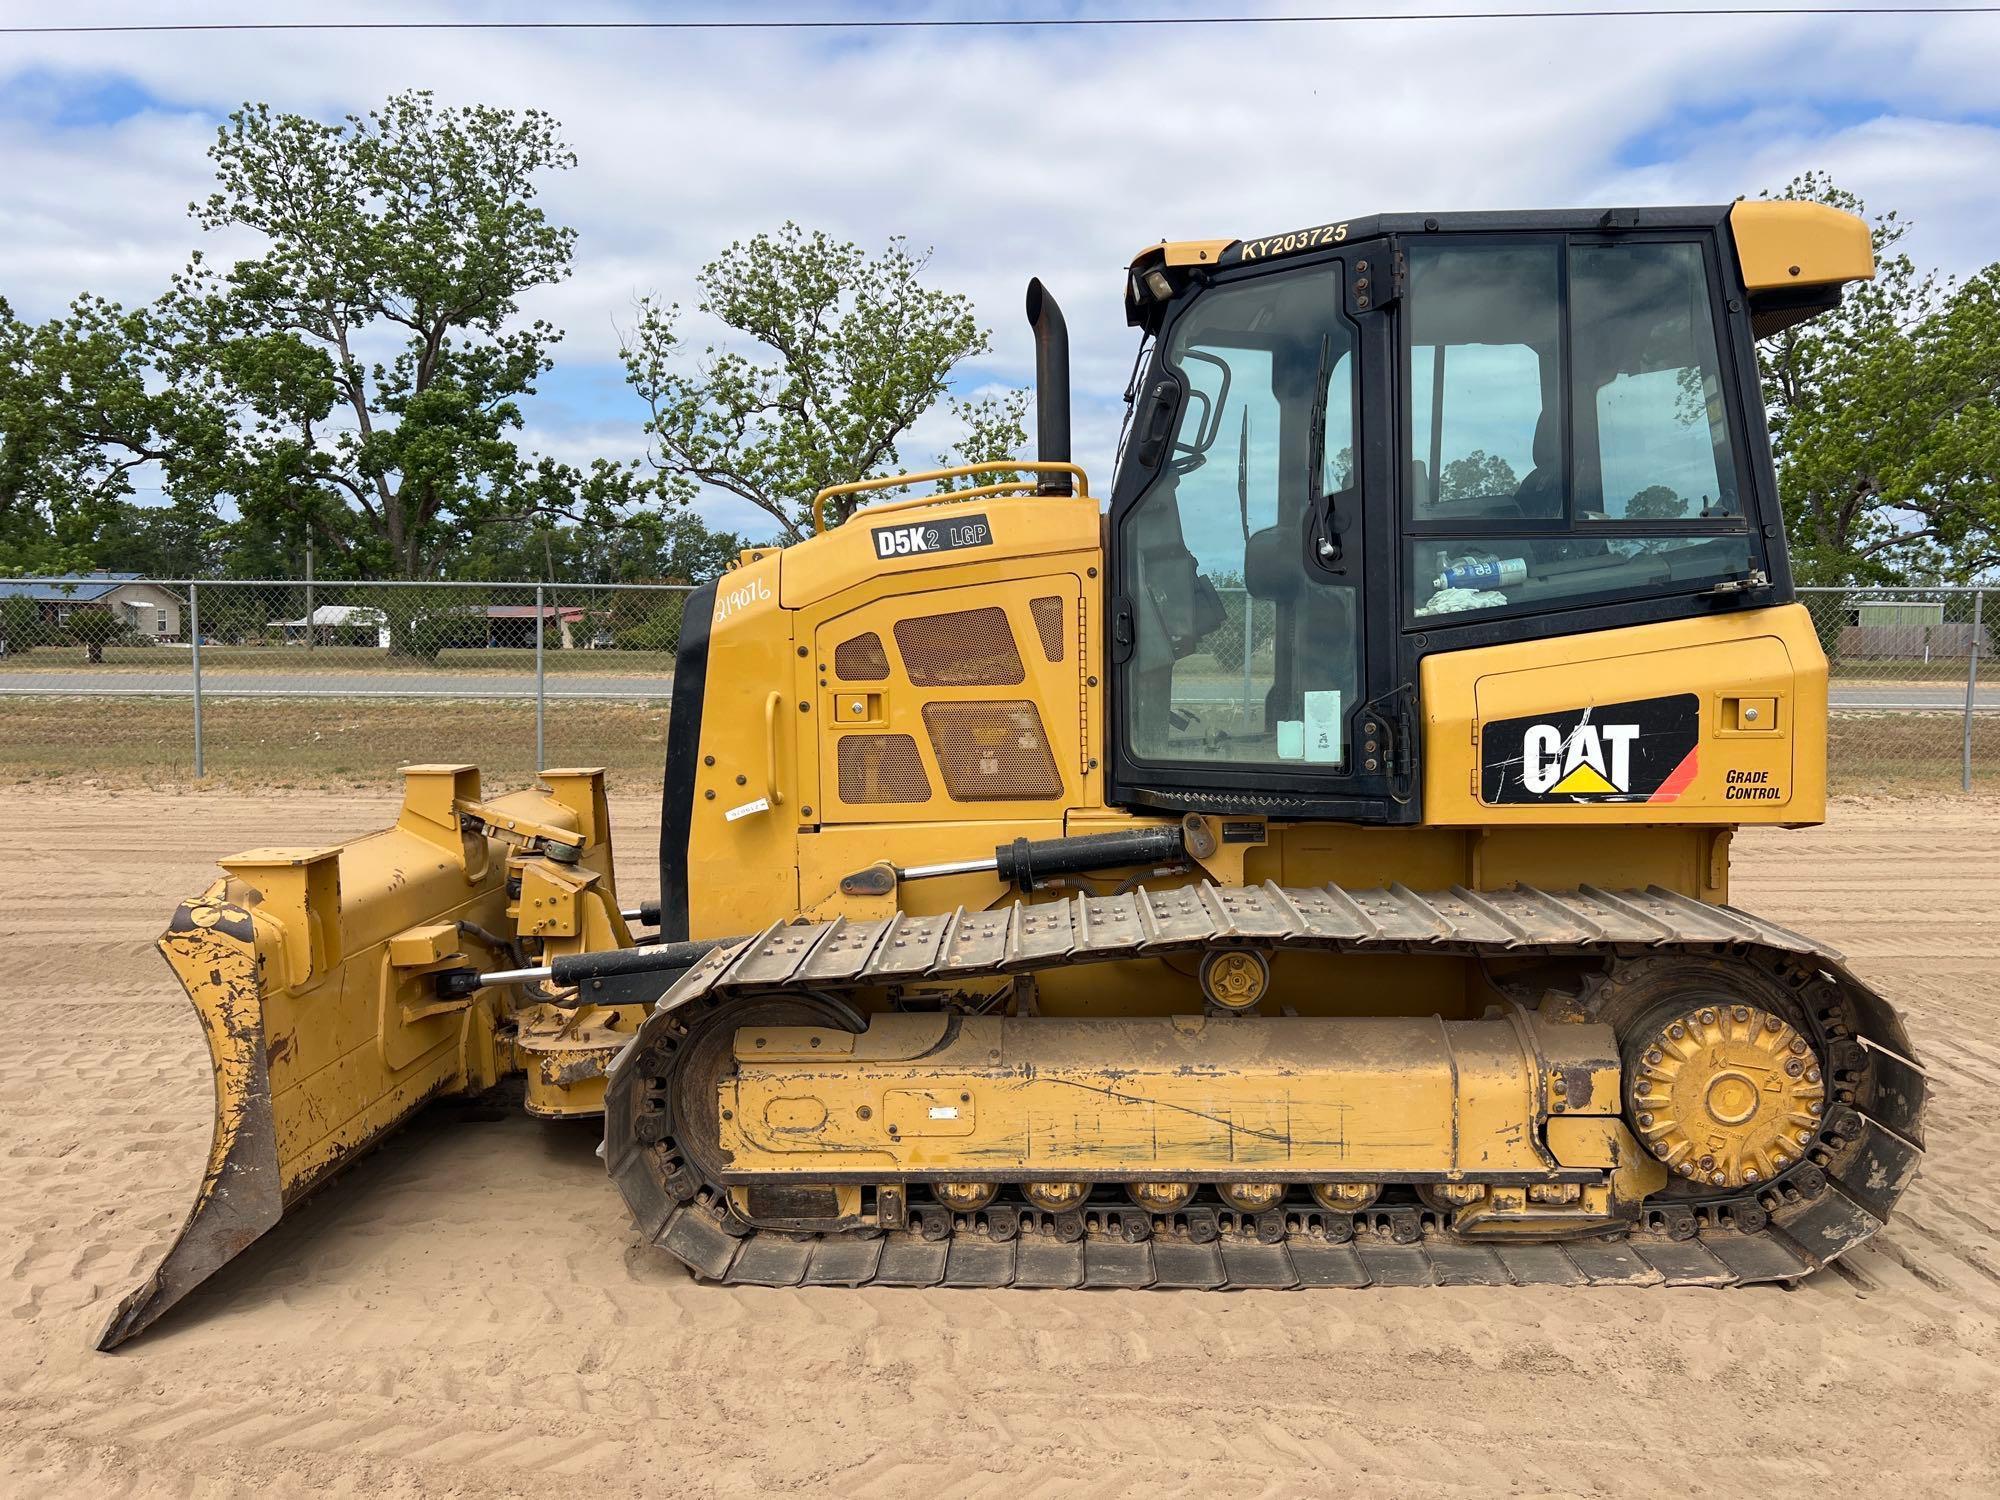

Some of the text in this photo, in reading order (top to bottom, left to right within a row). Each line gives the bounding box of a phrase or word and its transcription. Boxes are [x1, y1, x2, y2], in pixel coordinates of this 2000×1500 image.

[1241, 223, 1349, 261] KY203725
[950, 524, 987, 547] LGP
[714, 576, 771, 623] 219076
[1523, 724, 1640, 794] CAT
[1725, 769, 1769, 784] GRADE
[1725, 785, 1781, 800] CONTROL
